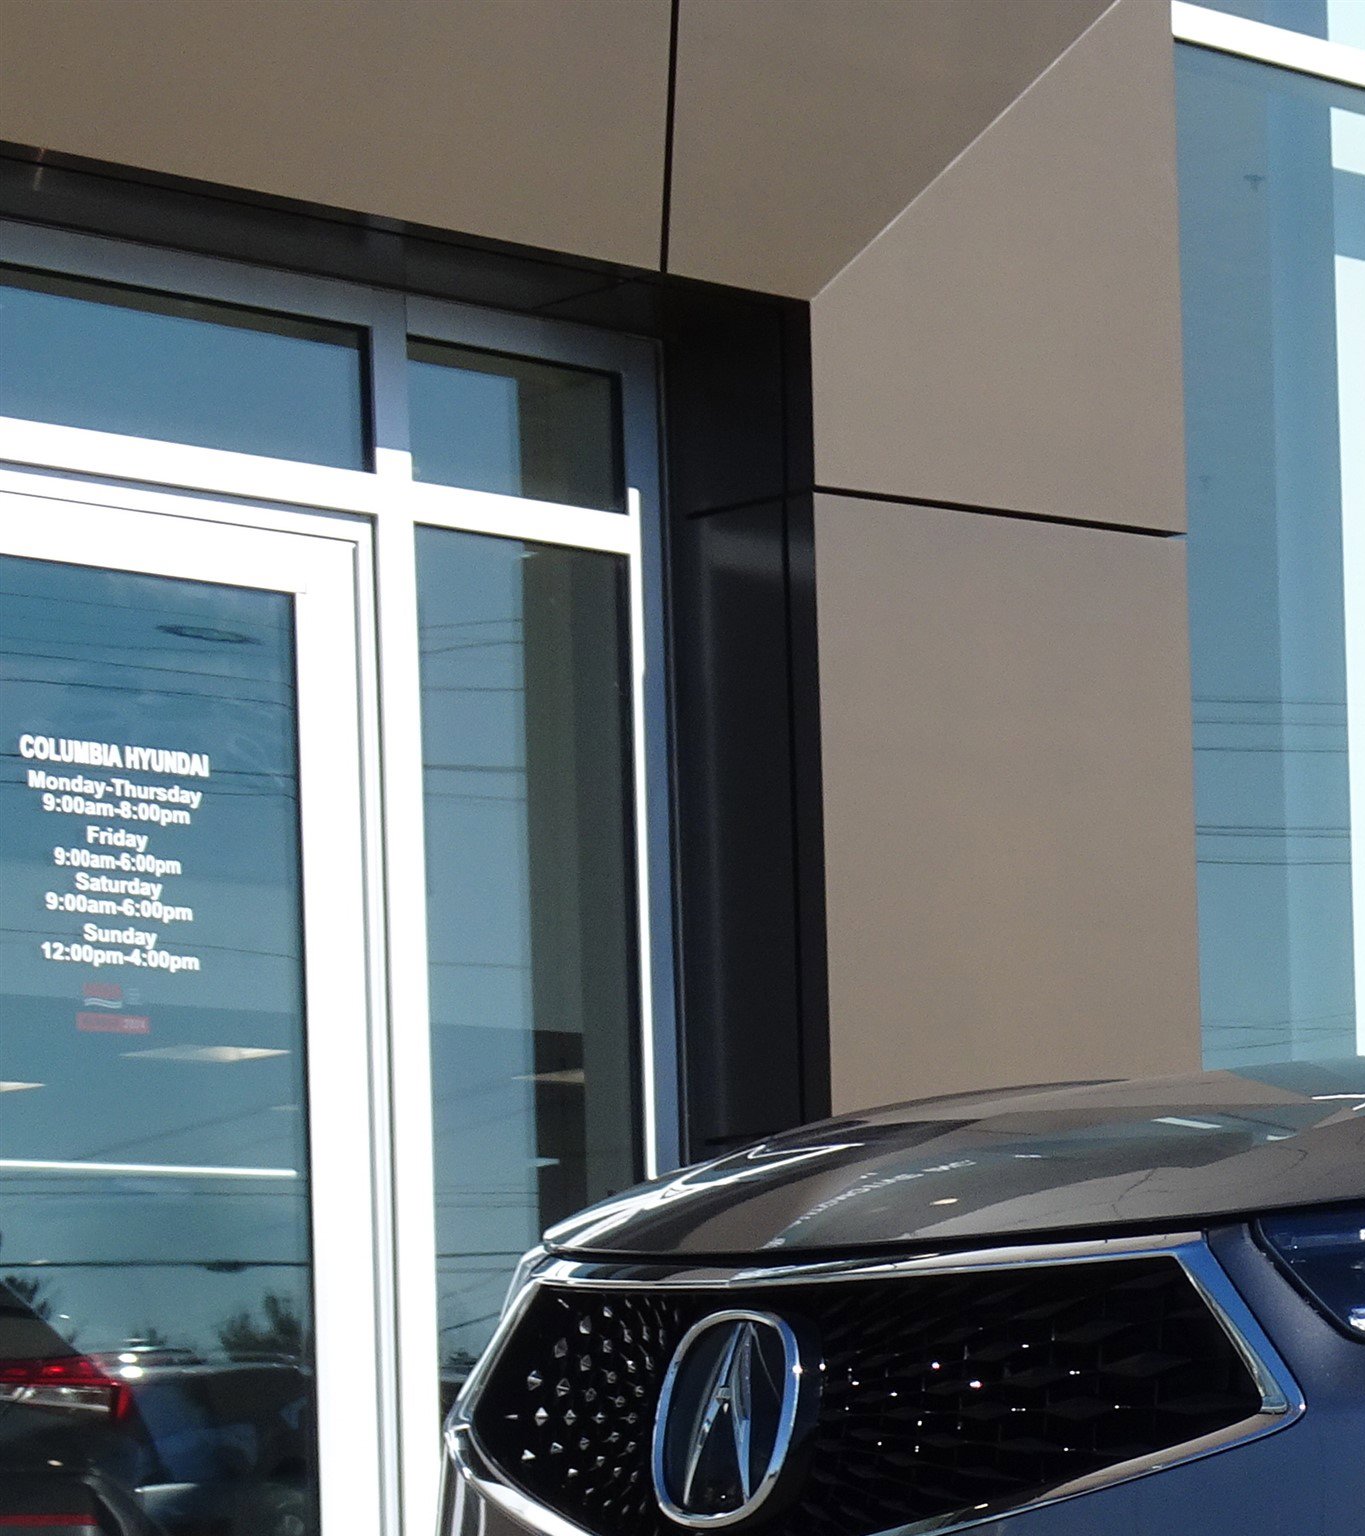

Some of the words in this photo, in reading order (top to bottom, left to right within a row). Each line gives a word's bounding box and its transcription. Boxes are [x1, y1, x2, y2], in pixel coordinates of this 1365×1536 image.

[19, 734, 122, 769] COLUMBIA
[124, 746, 210, 777] HYUNDAI
[27, 770, 202, 809] Monday-Thursday
[42, 794, 191, 826] 9:00am-8:00pm
[86, 826, 148, 853] Friday
[53, 847, 182, 877] 9:00am-6:00pm
[75, 872, 163, 900] Saturday
[45, 892, 193, 923] 9:00am-6:00pm
[83, 923, 157, 950] Sunday
[41, 942, 200, 973] 12:00pm-4:00pm
